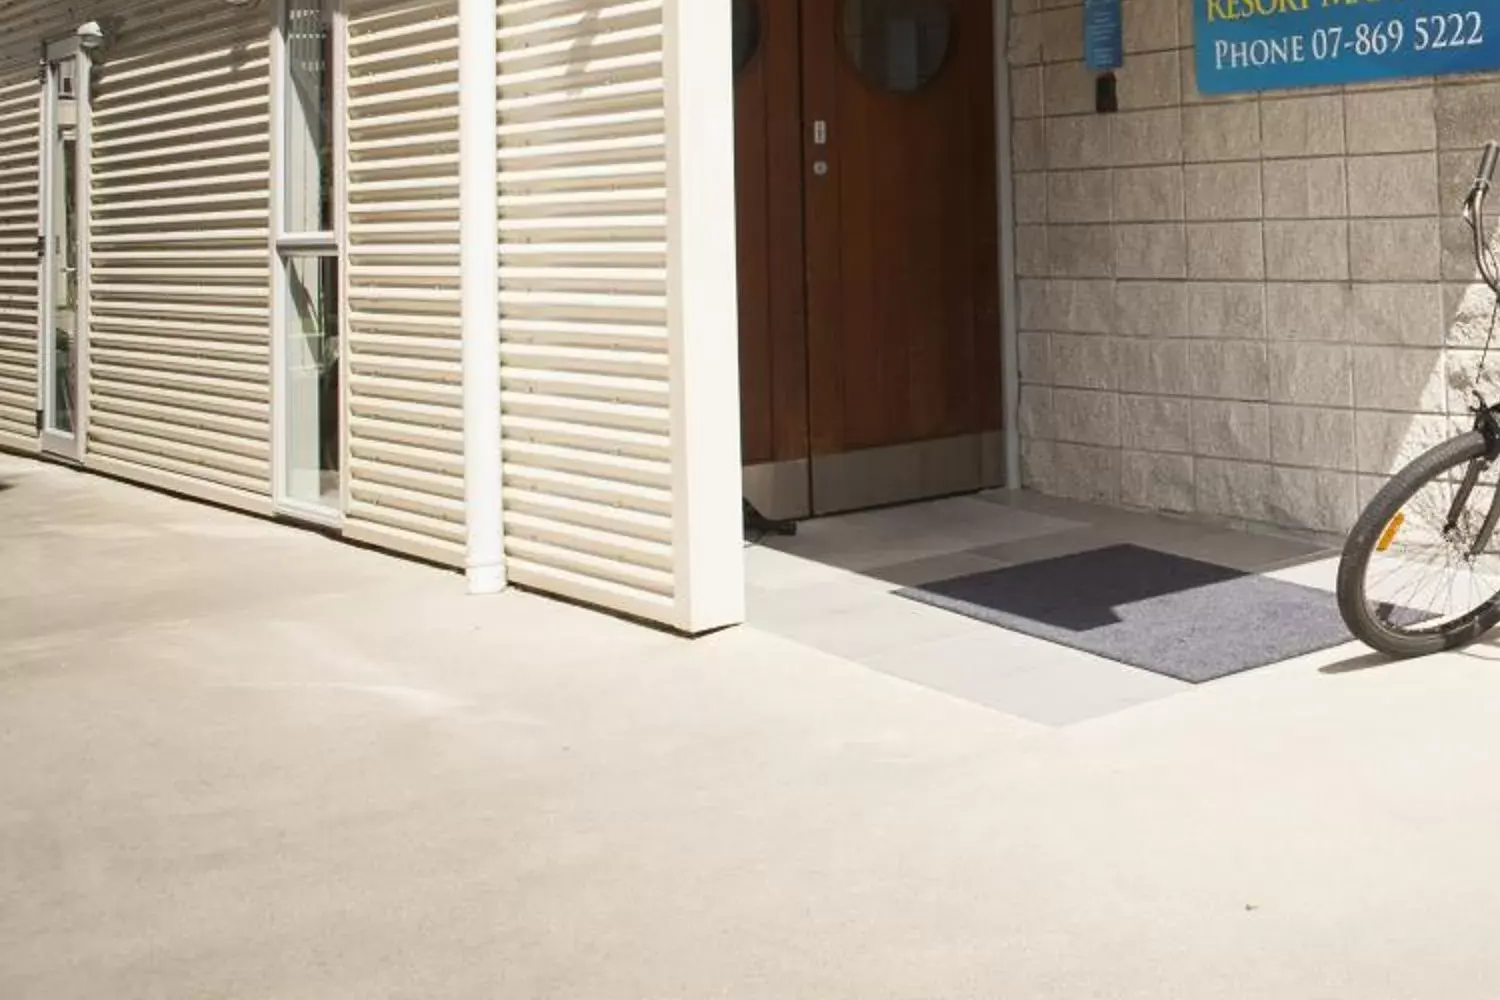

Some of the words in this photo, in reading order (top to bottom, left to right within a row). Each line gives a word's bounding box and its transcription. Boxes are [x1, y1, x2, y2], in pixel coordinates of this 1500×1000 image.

[1215, 35, 1305, 70] PHONE
[1312, 20, 1404, 60] 07-869
[1415, 11, 1484, 50] 5222
